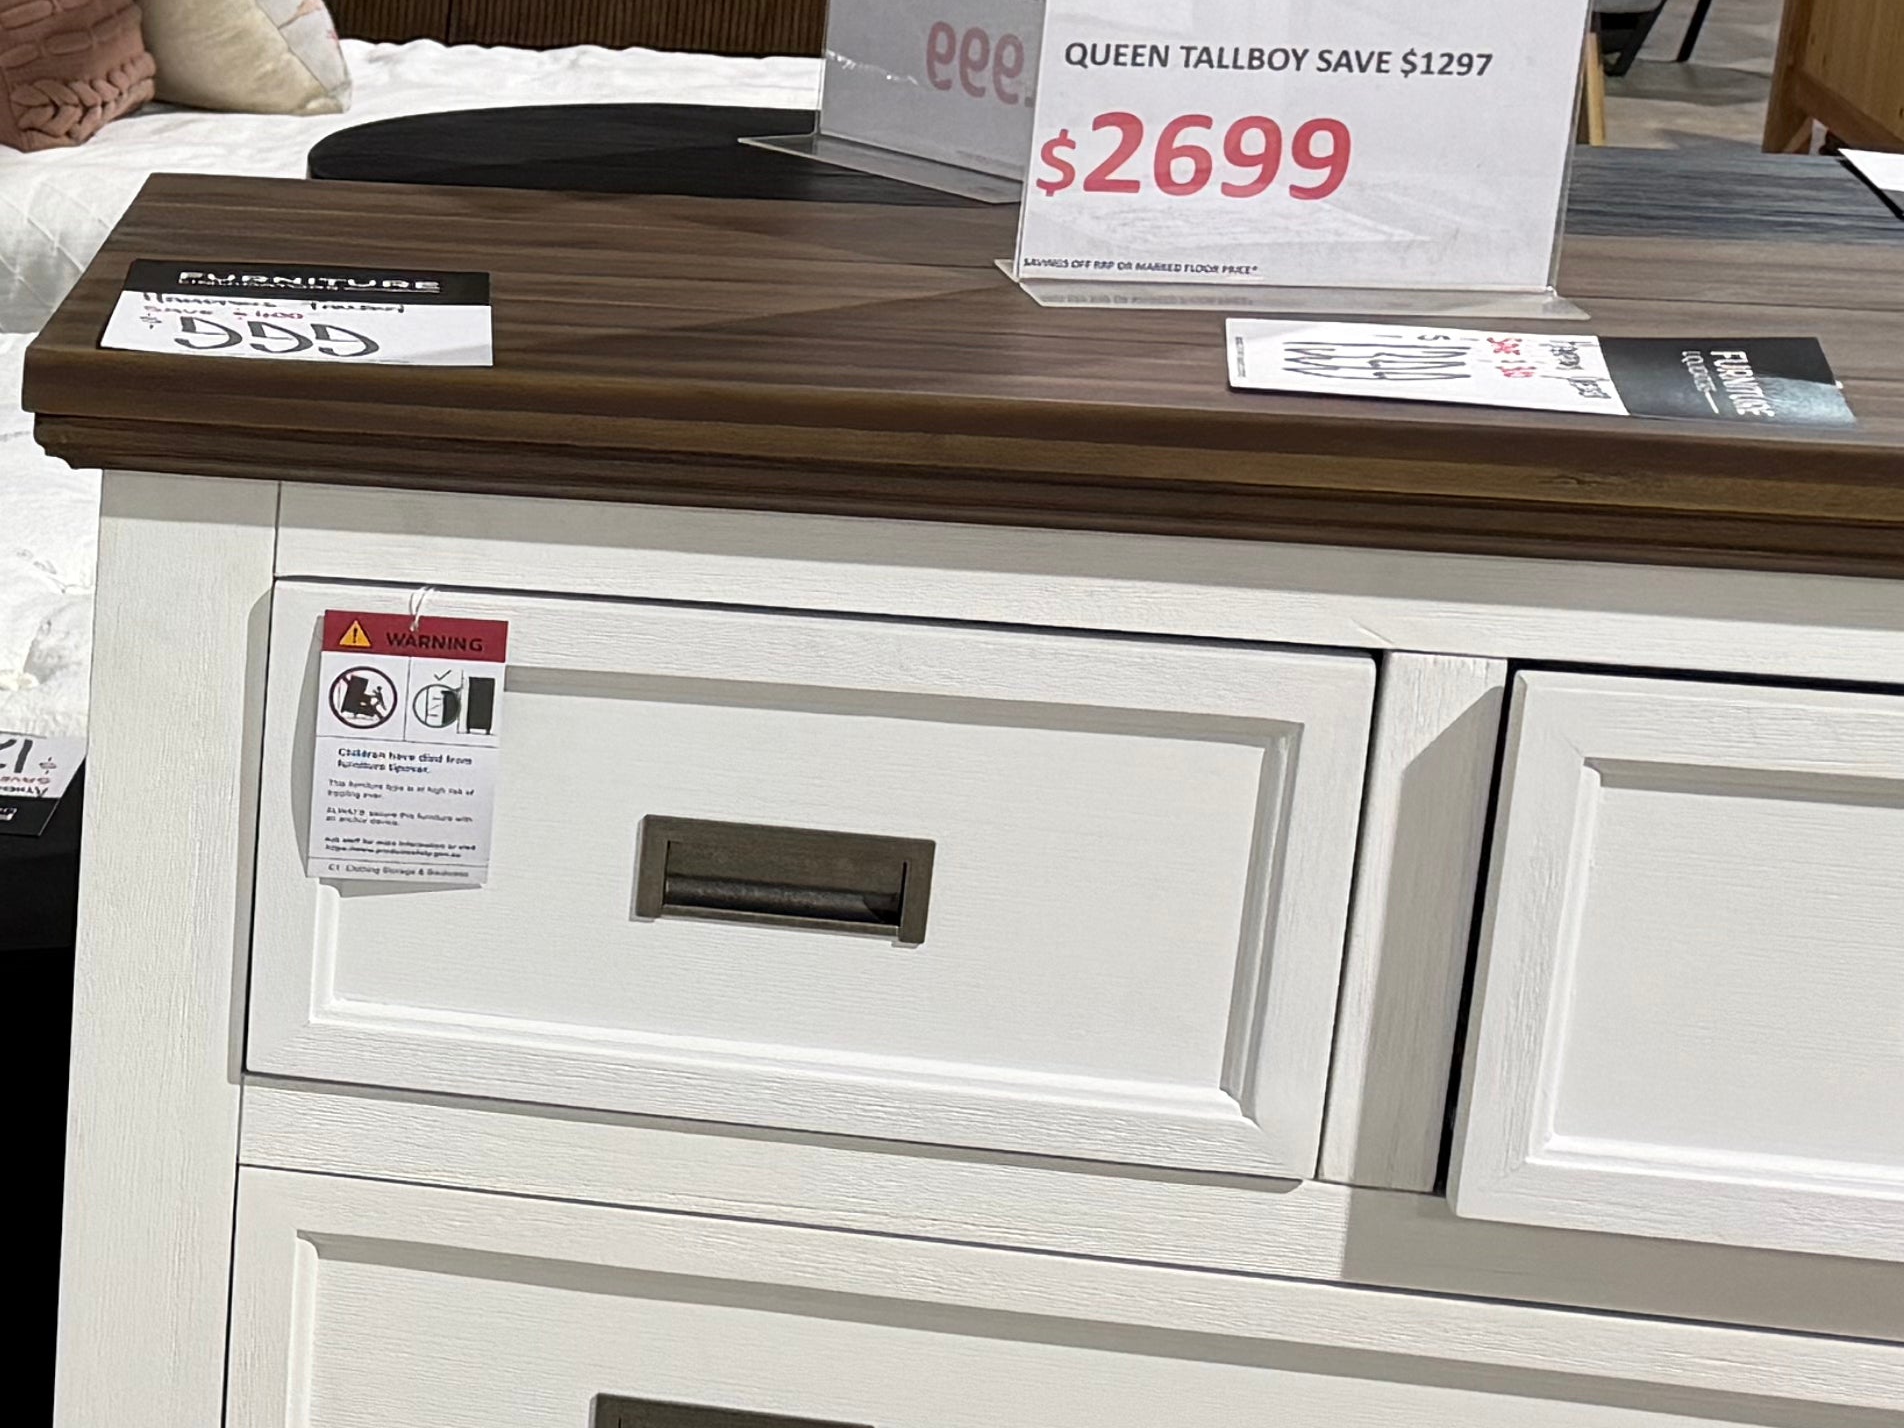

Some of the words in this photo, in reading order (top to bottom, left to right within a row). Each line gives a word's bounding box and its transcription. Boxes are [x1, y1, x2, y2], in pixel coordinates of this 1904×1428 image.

[1064, 42, 1170, 69] QUEEN
[1179, 44, 1310, 72] TALLBOY
[1316, 48, 1393, 74] SAVE
[1400, 48, 1494, 79] $1297
[1035, 110, 1352, 201] $2699
[178, 271, 441, 291] FURNITURE
[385, 631, 484, 653] WARNING
